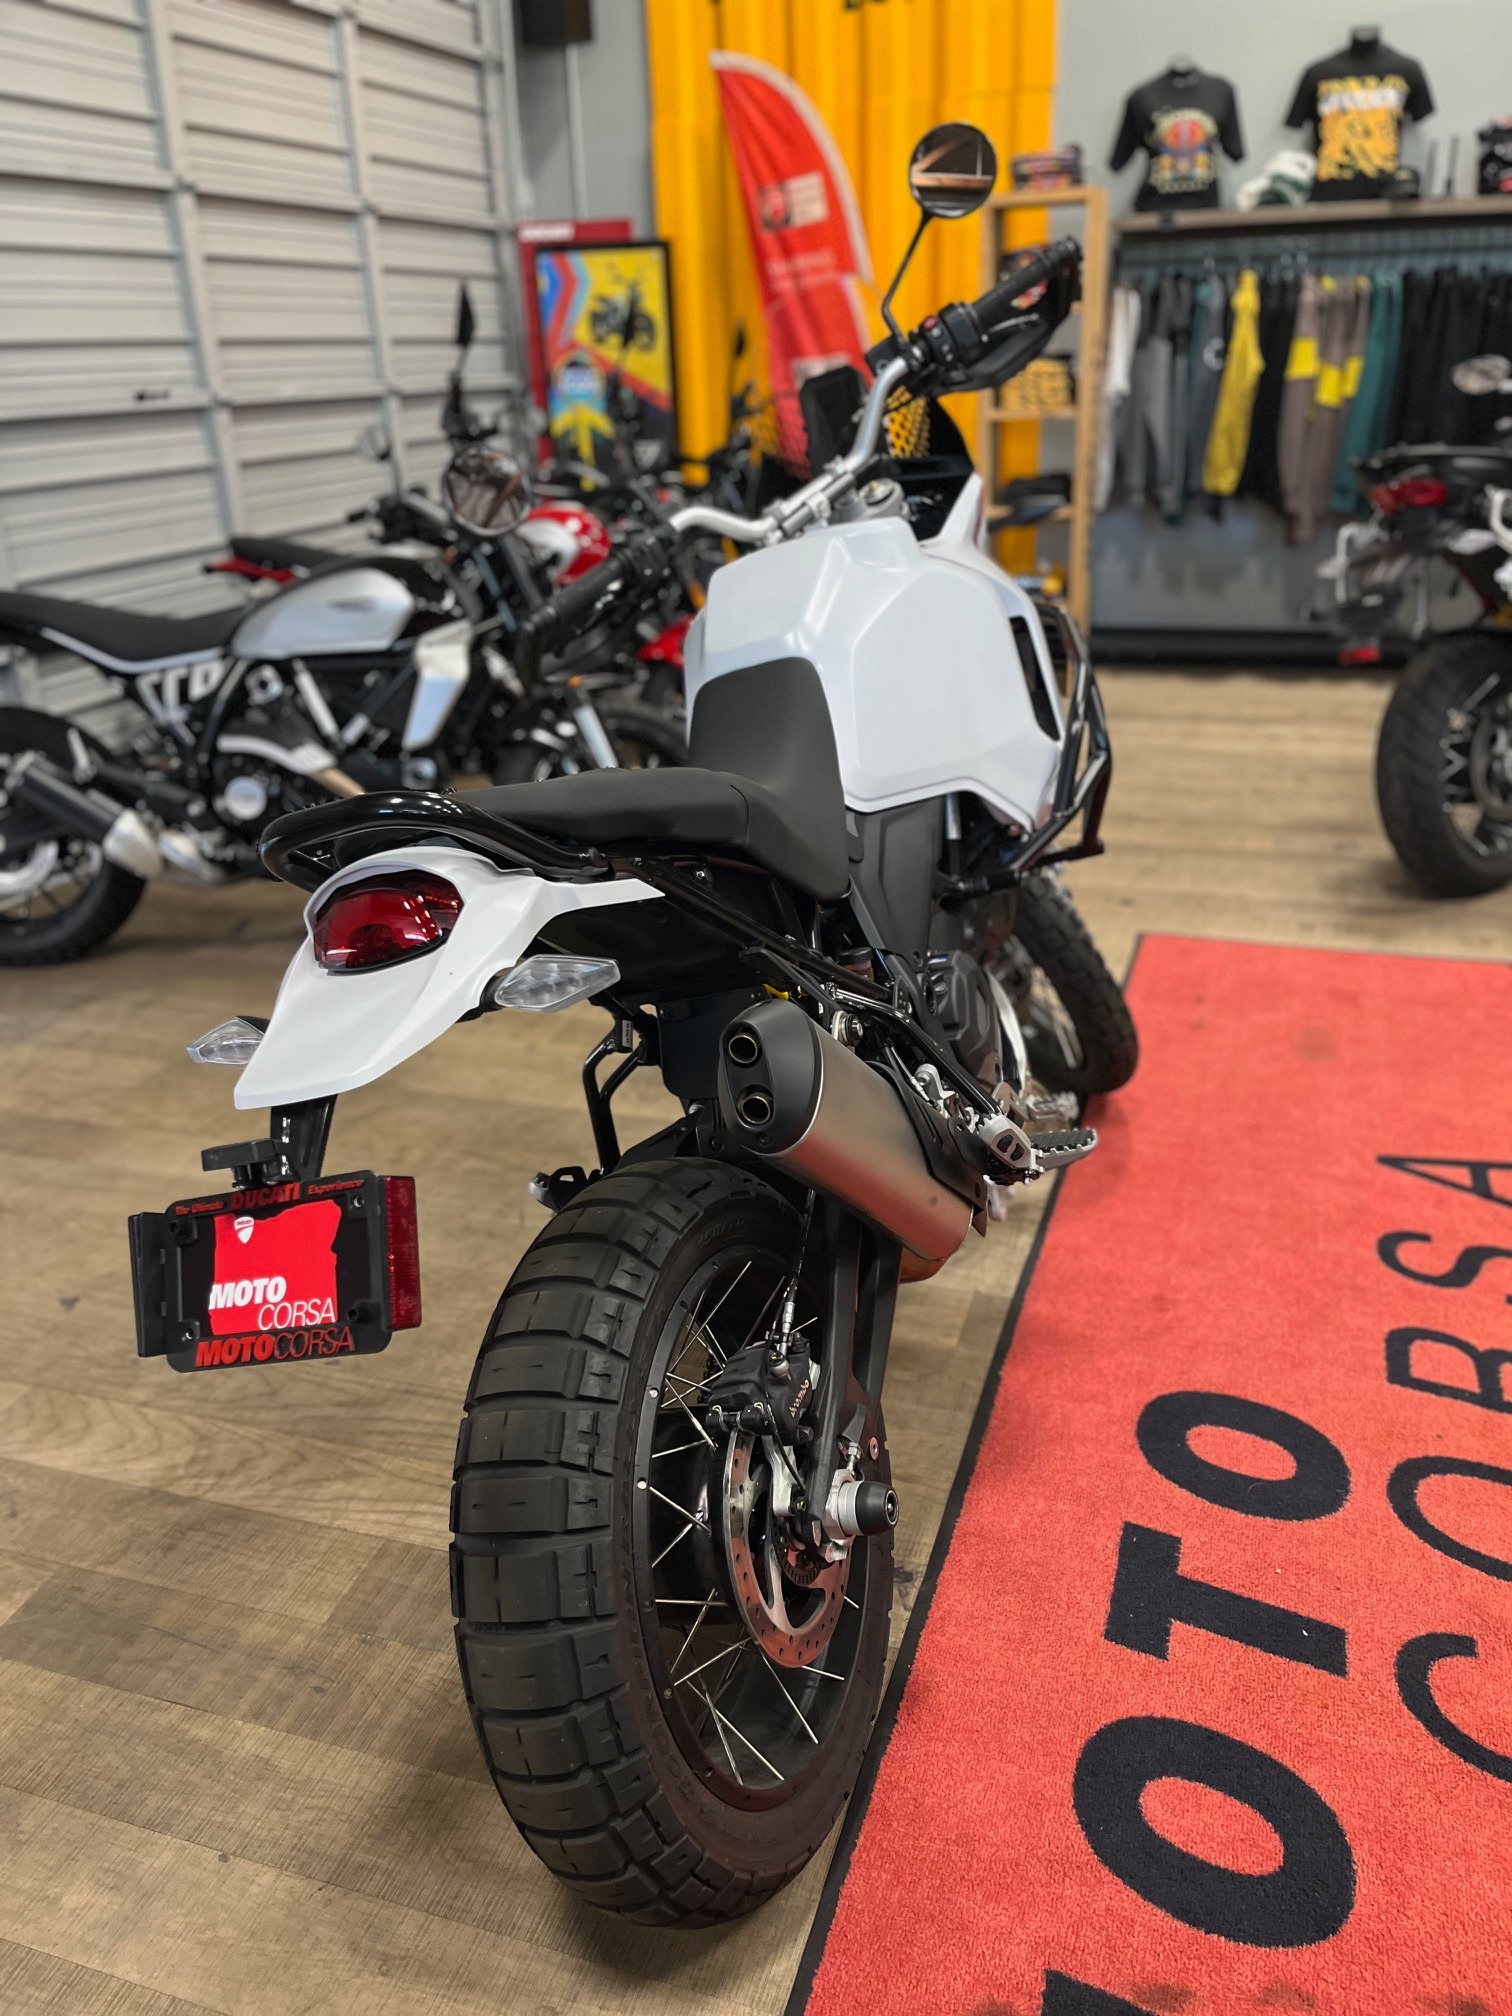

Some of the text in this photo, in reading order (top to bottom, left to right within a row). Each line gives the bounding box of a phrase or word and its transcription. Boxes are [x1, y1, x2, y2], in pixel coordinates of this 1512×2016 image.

[230, 1183, 301, 1210] DUCATI
[307, 1179, 364, 1195] Experience
[208, 1276, 287, 1311] MOTO
[257, 1297, 336, 1331] CORSA
[195, 1326, 356, 1368] MOTOCORSA
[1041, 1391, 1356, 2016] OTO
